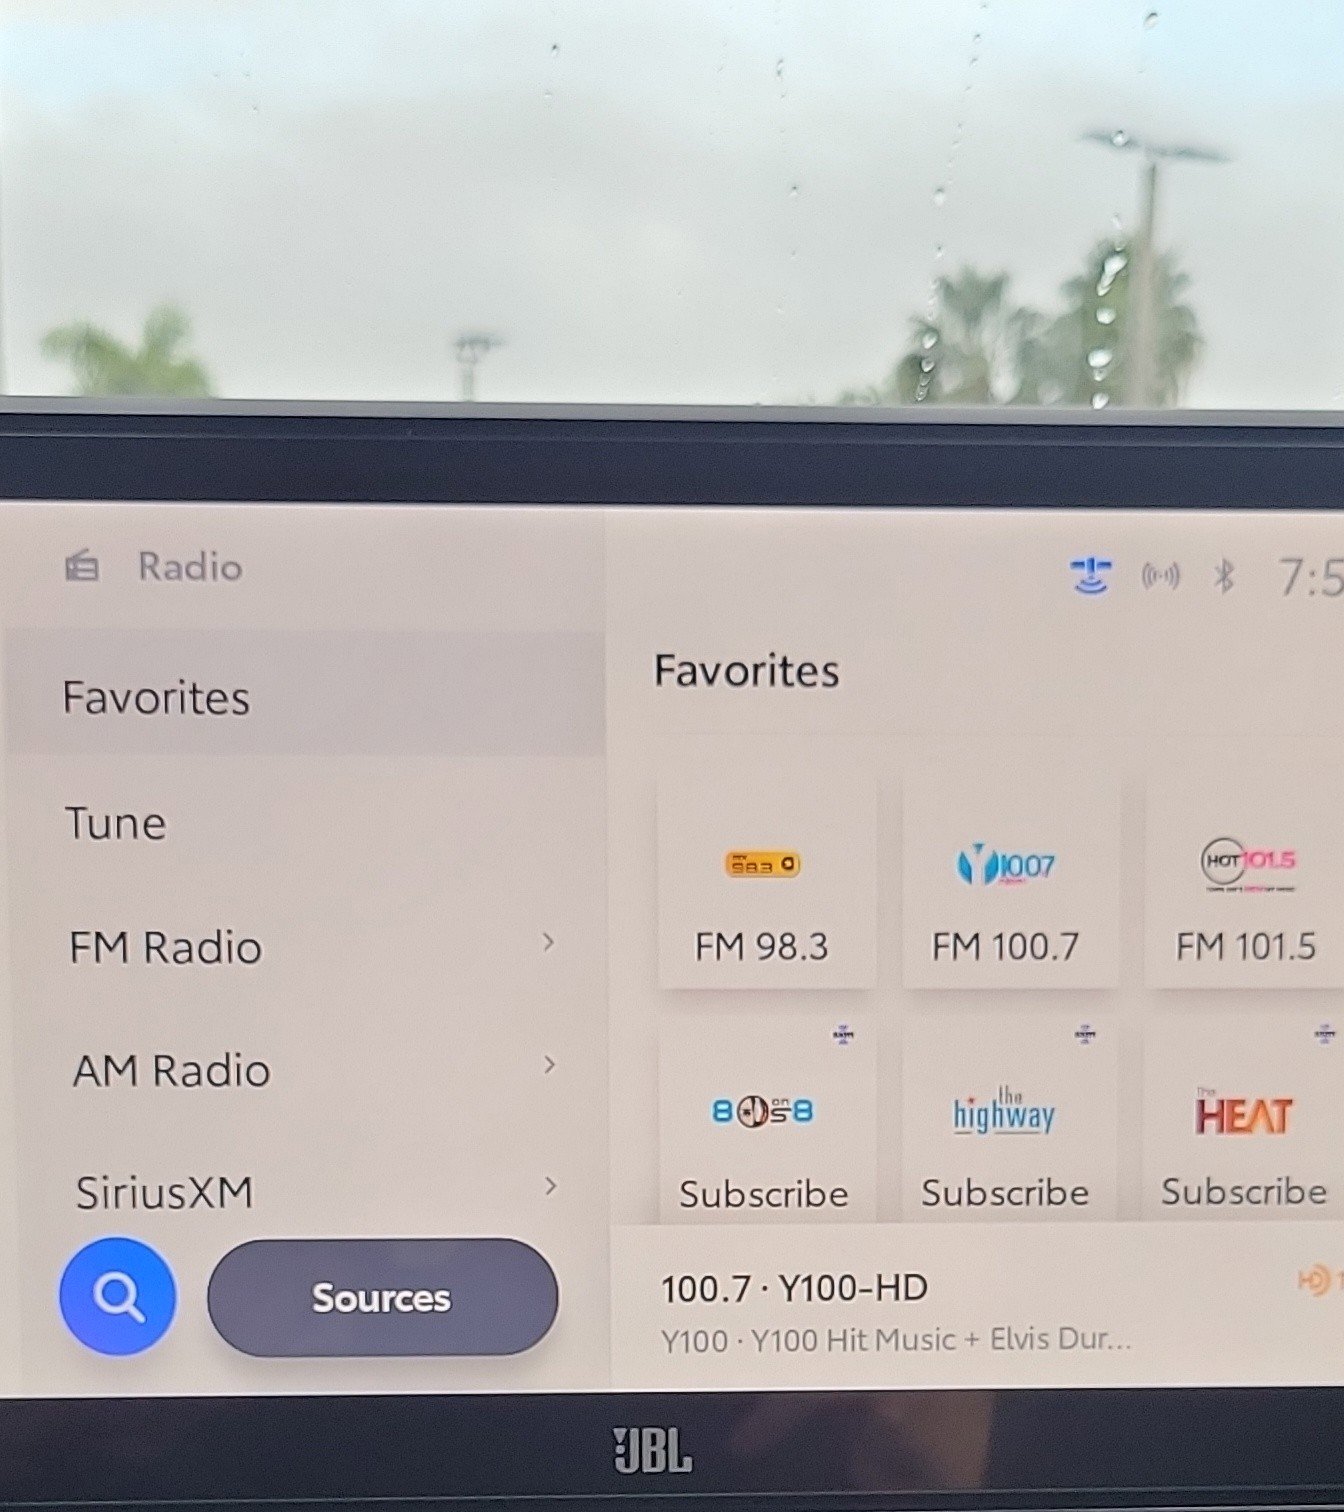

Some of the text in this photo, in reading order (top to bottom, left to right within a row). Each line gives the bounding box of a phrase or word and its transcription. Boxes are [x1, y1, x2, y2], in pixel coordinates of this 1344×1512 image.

[138, 550, 244, 583] Radio
[654, 651, 841, 690] Favorites
[62, 679, 252, 717] Favorites
[65, 806, 168, 841] Tune
[68, 929, 264, 966] FM Radio
[695, 931, 829, 961] FM 98.3
[933, 931, 1080, 961] FM 100.7
[1176, 931, 1317, 961] FM 101.5
[72, 1052, 272, 1090] AM Radio
[953, 1098, 1055, 1136] highway
[1195, 1098, 1294, 1135] HEAT
[75, 1175, 254, 1211] SiriusXM
[680, 1178, 849, 1209] Subscribe
[922, 1177, 1090, 1207] Subscribe
[1161, 1176, 1328, 1206] Subscribe
[312, 1283, 452, 1314] Sources
[662, 1274, 752, 1303] 100.7
[778, 1273, 929, 1303] Y100-HD
[660, 1329, 729, 1354] Y100
[750, 1328, 818, 1353] Y100
[827, 1327, 870, 1352] Hit
[875, 1326, 957, 1352] Music
[990, 1325, 1051, 1351] Elvis
[612, 1426, 694, 1474] JBL
